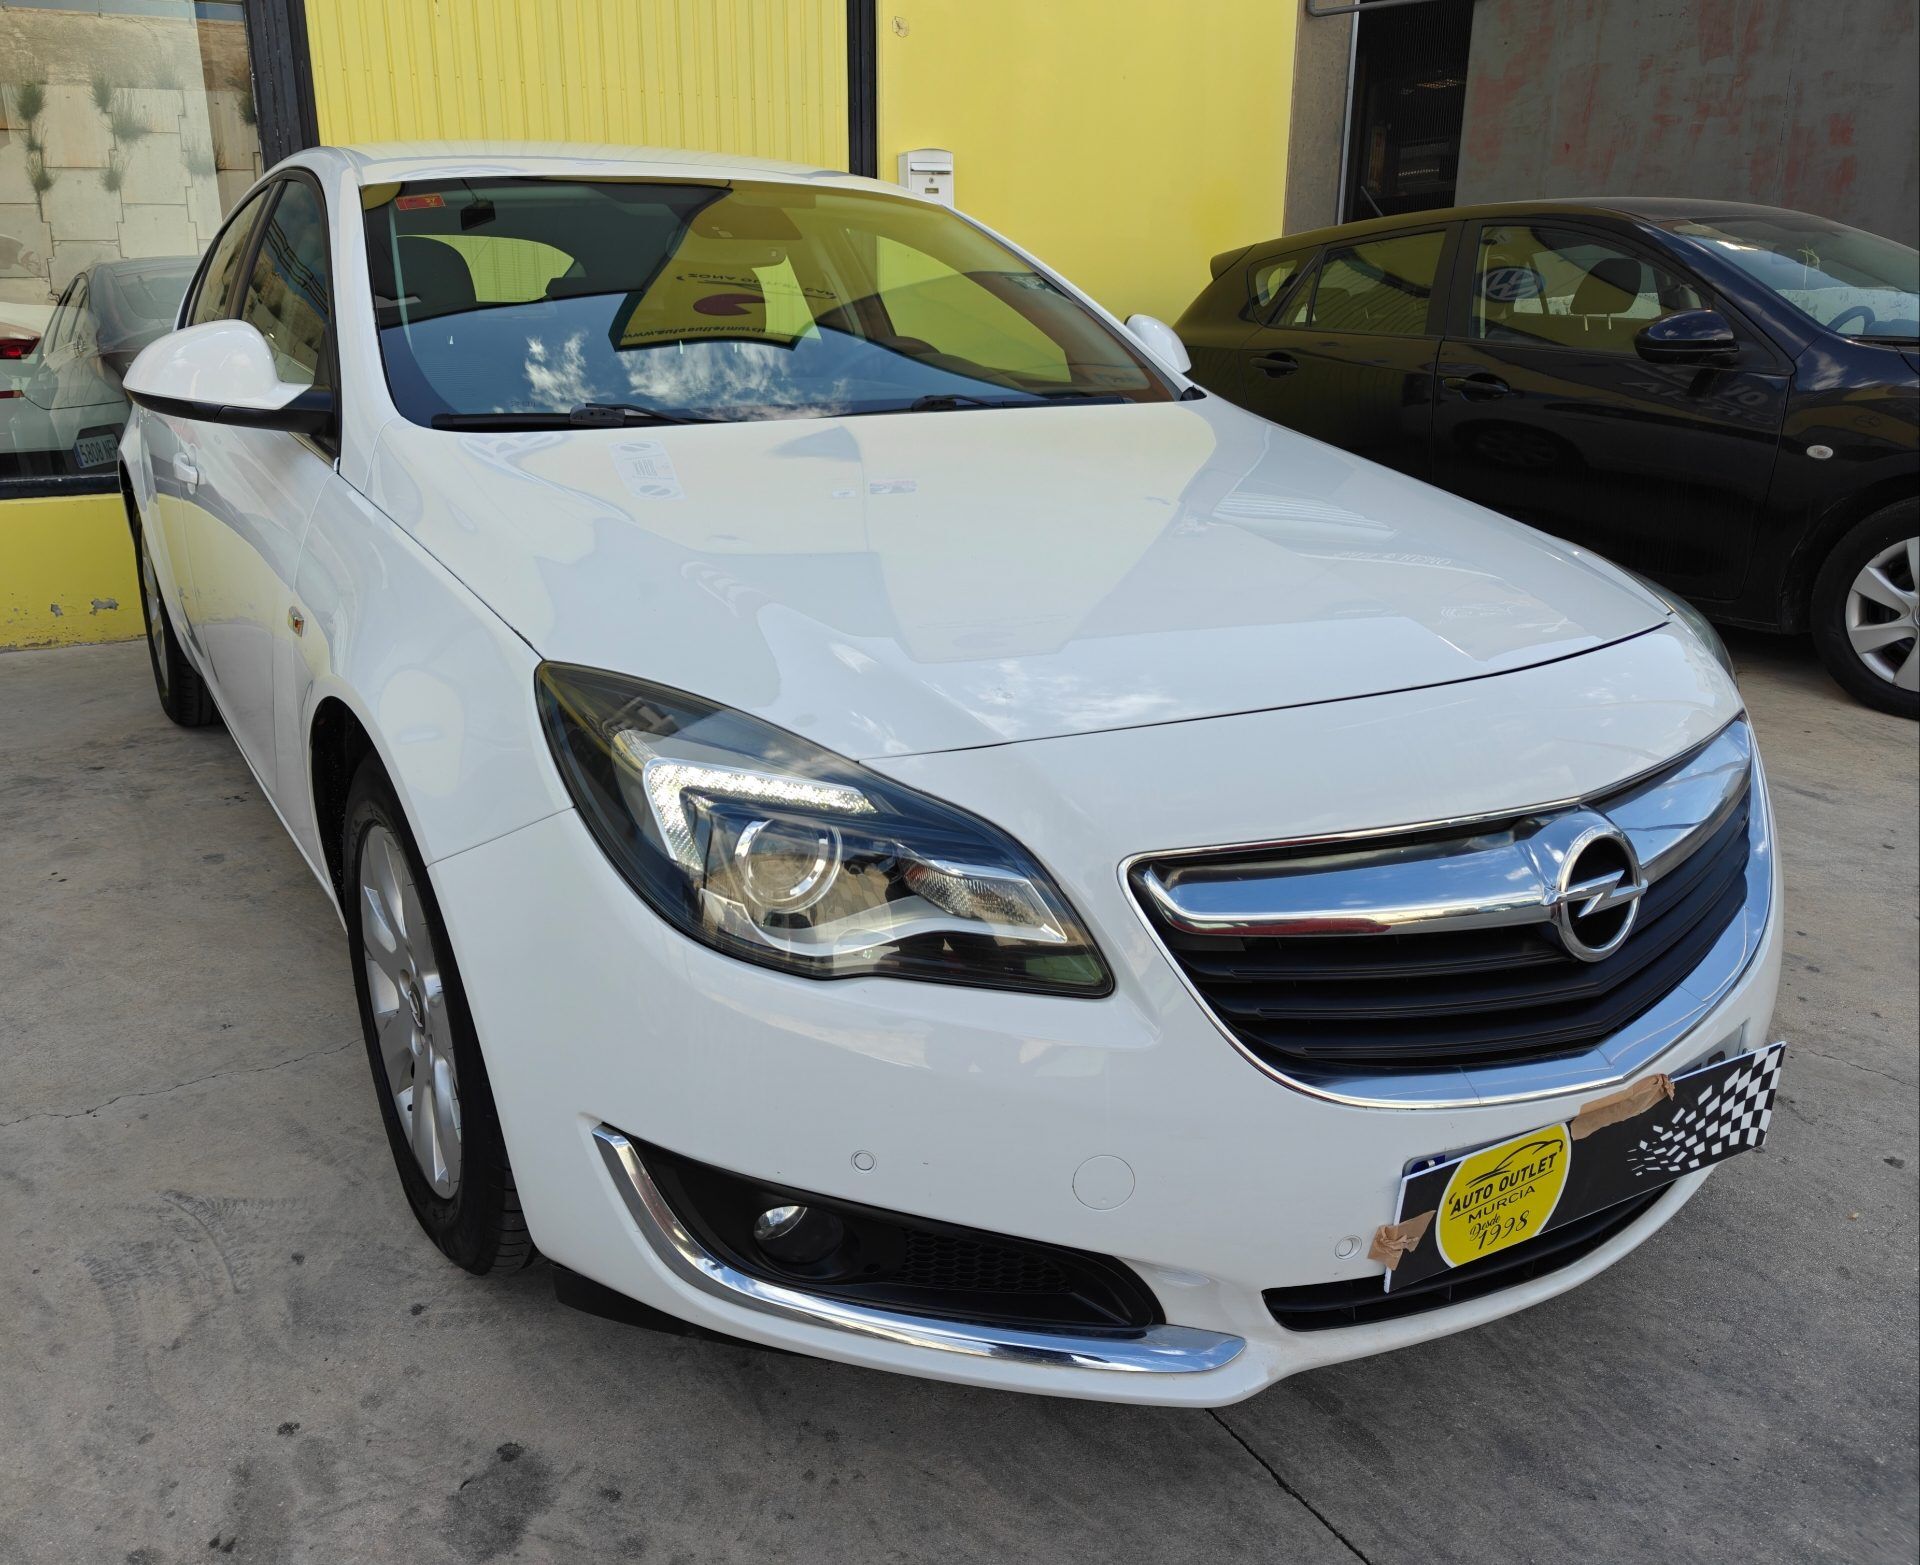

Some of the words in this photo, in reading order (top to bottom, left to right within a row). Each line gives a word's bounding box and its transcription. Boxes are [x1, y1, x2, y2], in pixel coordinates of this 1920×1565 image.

[1499, 1152, 1558, 1192] OUTLET
[1468, 1185, 1535, 1223] MURCIA
[1469, 1213, 1501, 1241] Desde
[1478, 1209, 1530, 1250] 1998
